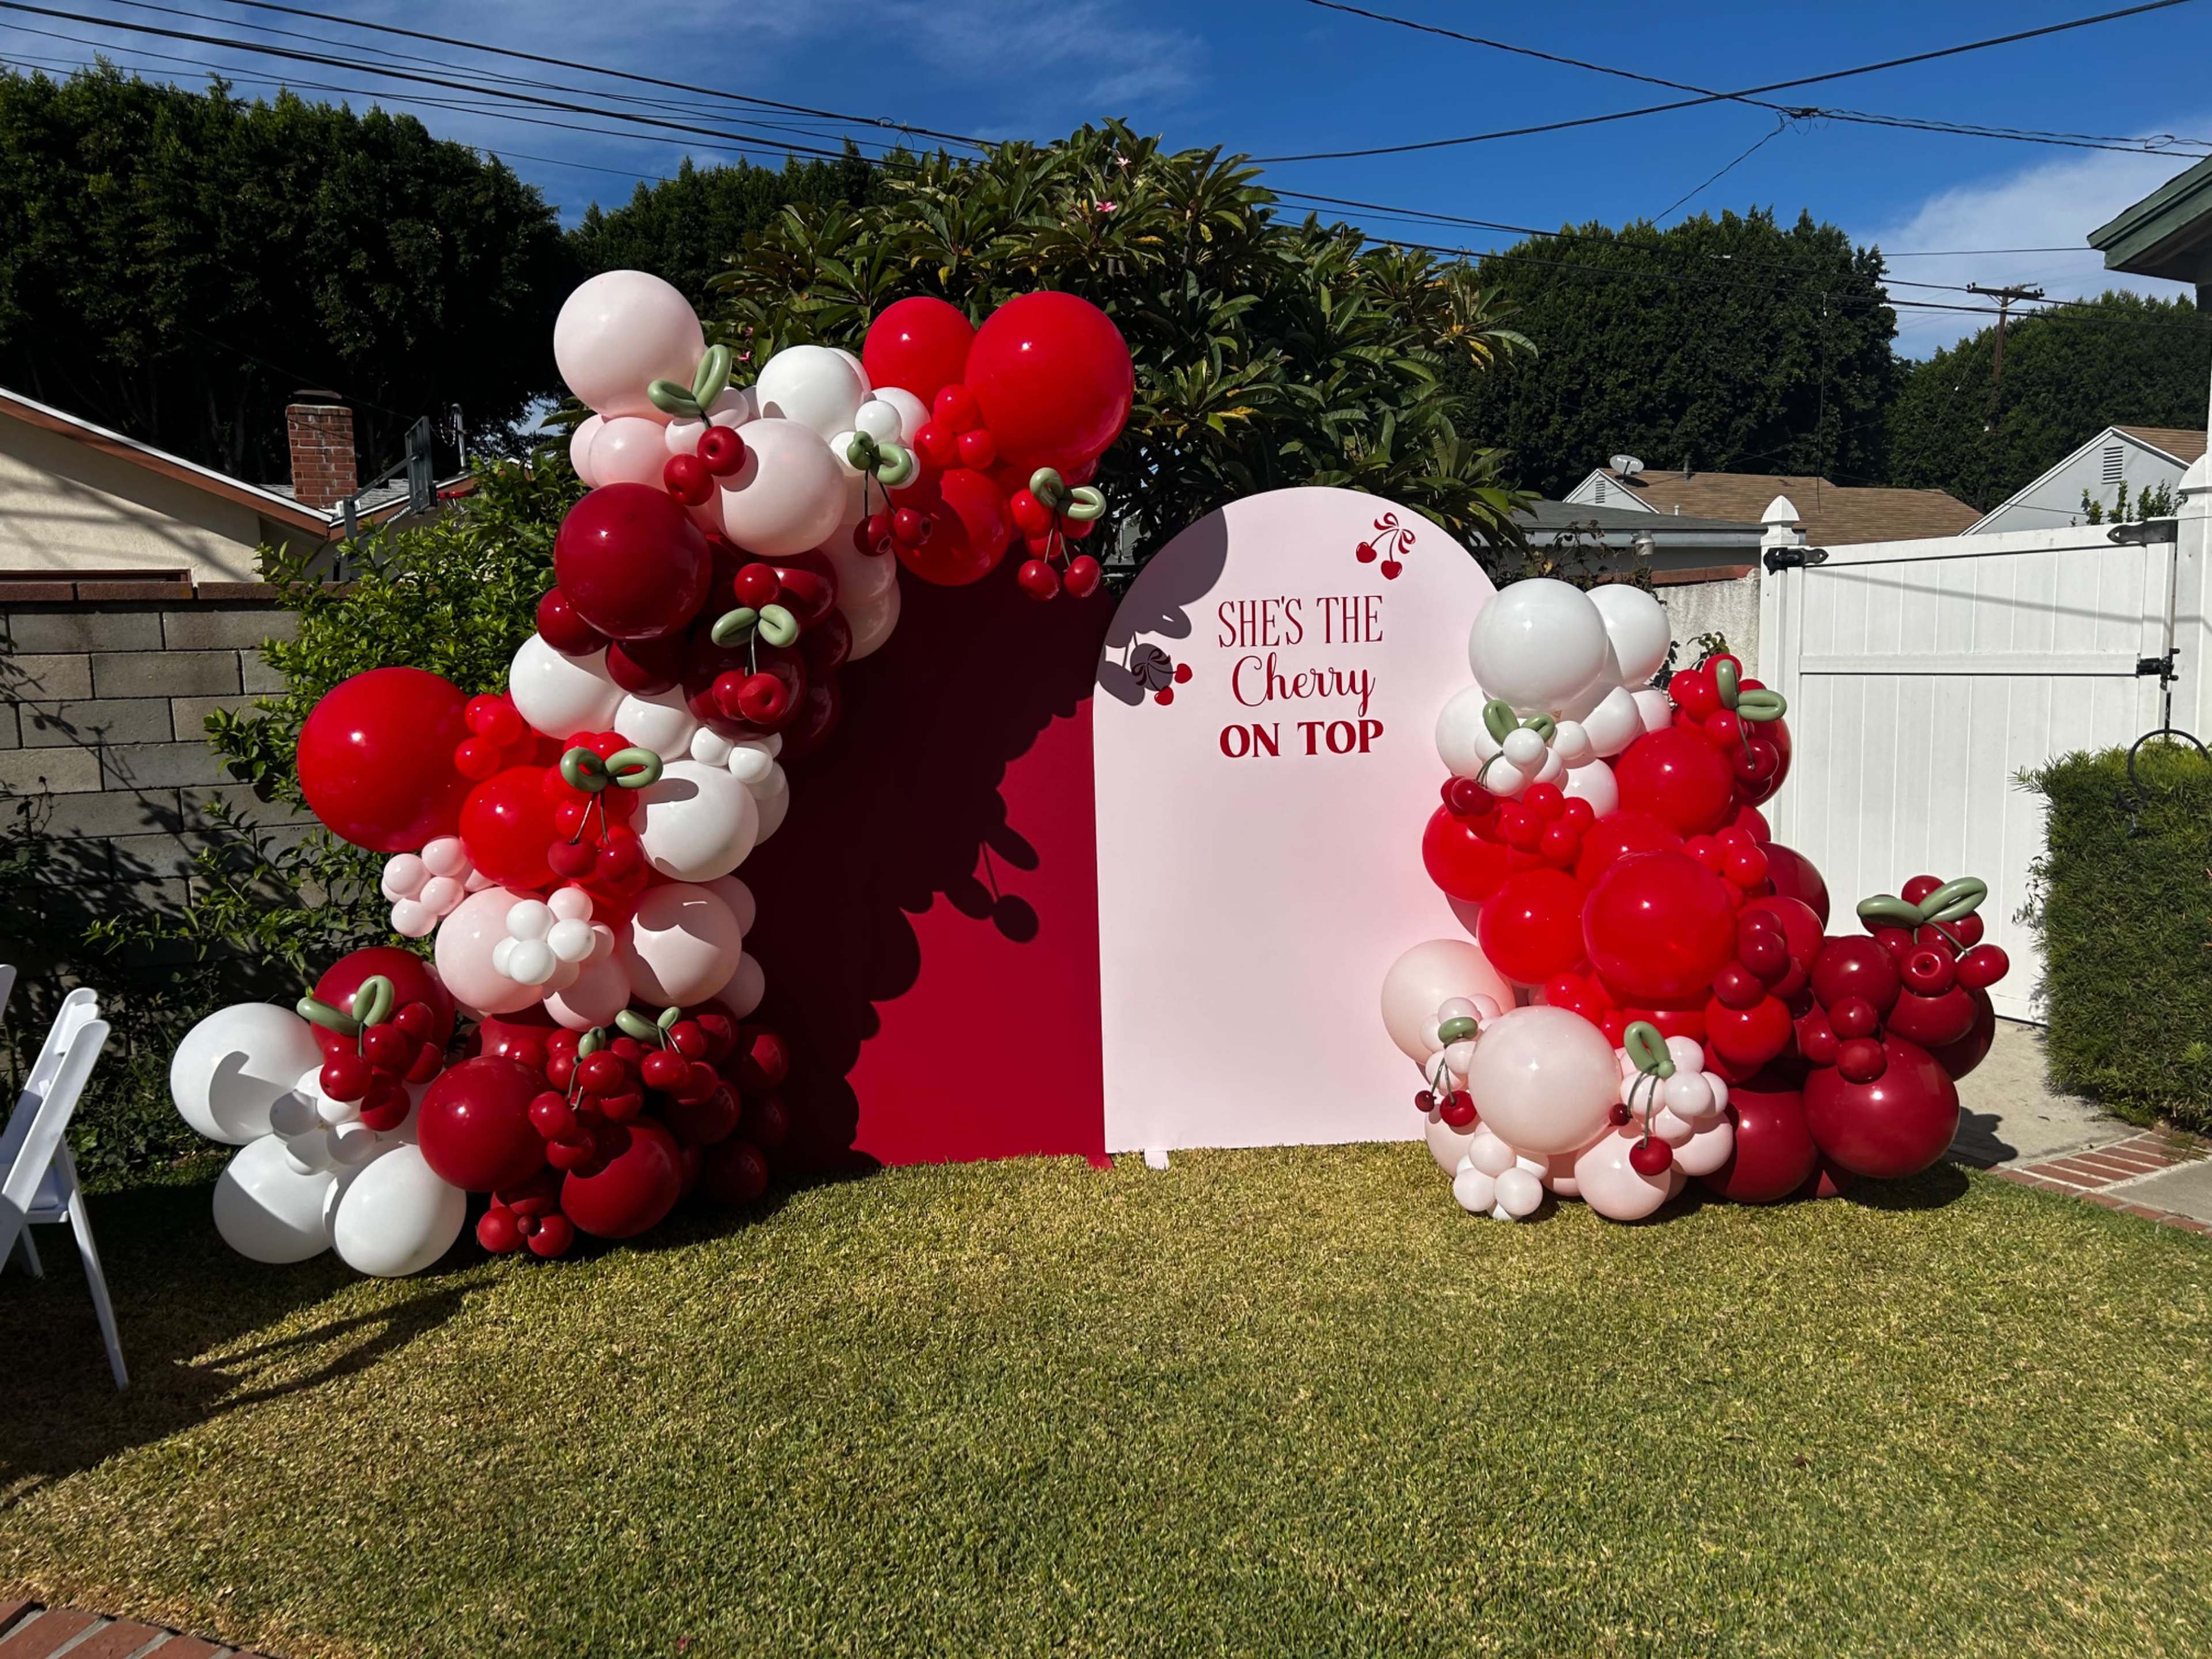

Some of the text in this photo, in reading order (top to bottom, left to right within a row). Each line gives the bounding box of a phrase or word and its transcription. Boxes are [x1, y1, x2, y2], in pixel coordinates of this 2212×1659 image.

[1218, 595, 1383, 648] SHE'S THE
[1232, 652, 1376, 717] Cherry
[1219, 719, 1384, 759] ON TOP
